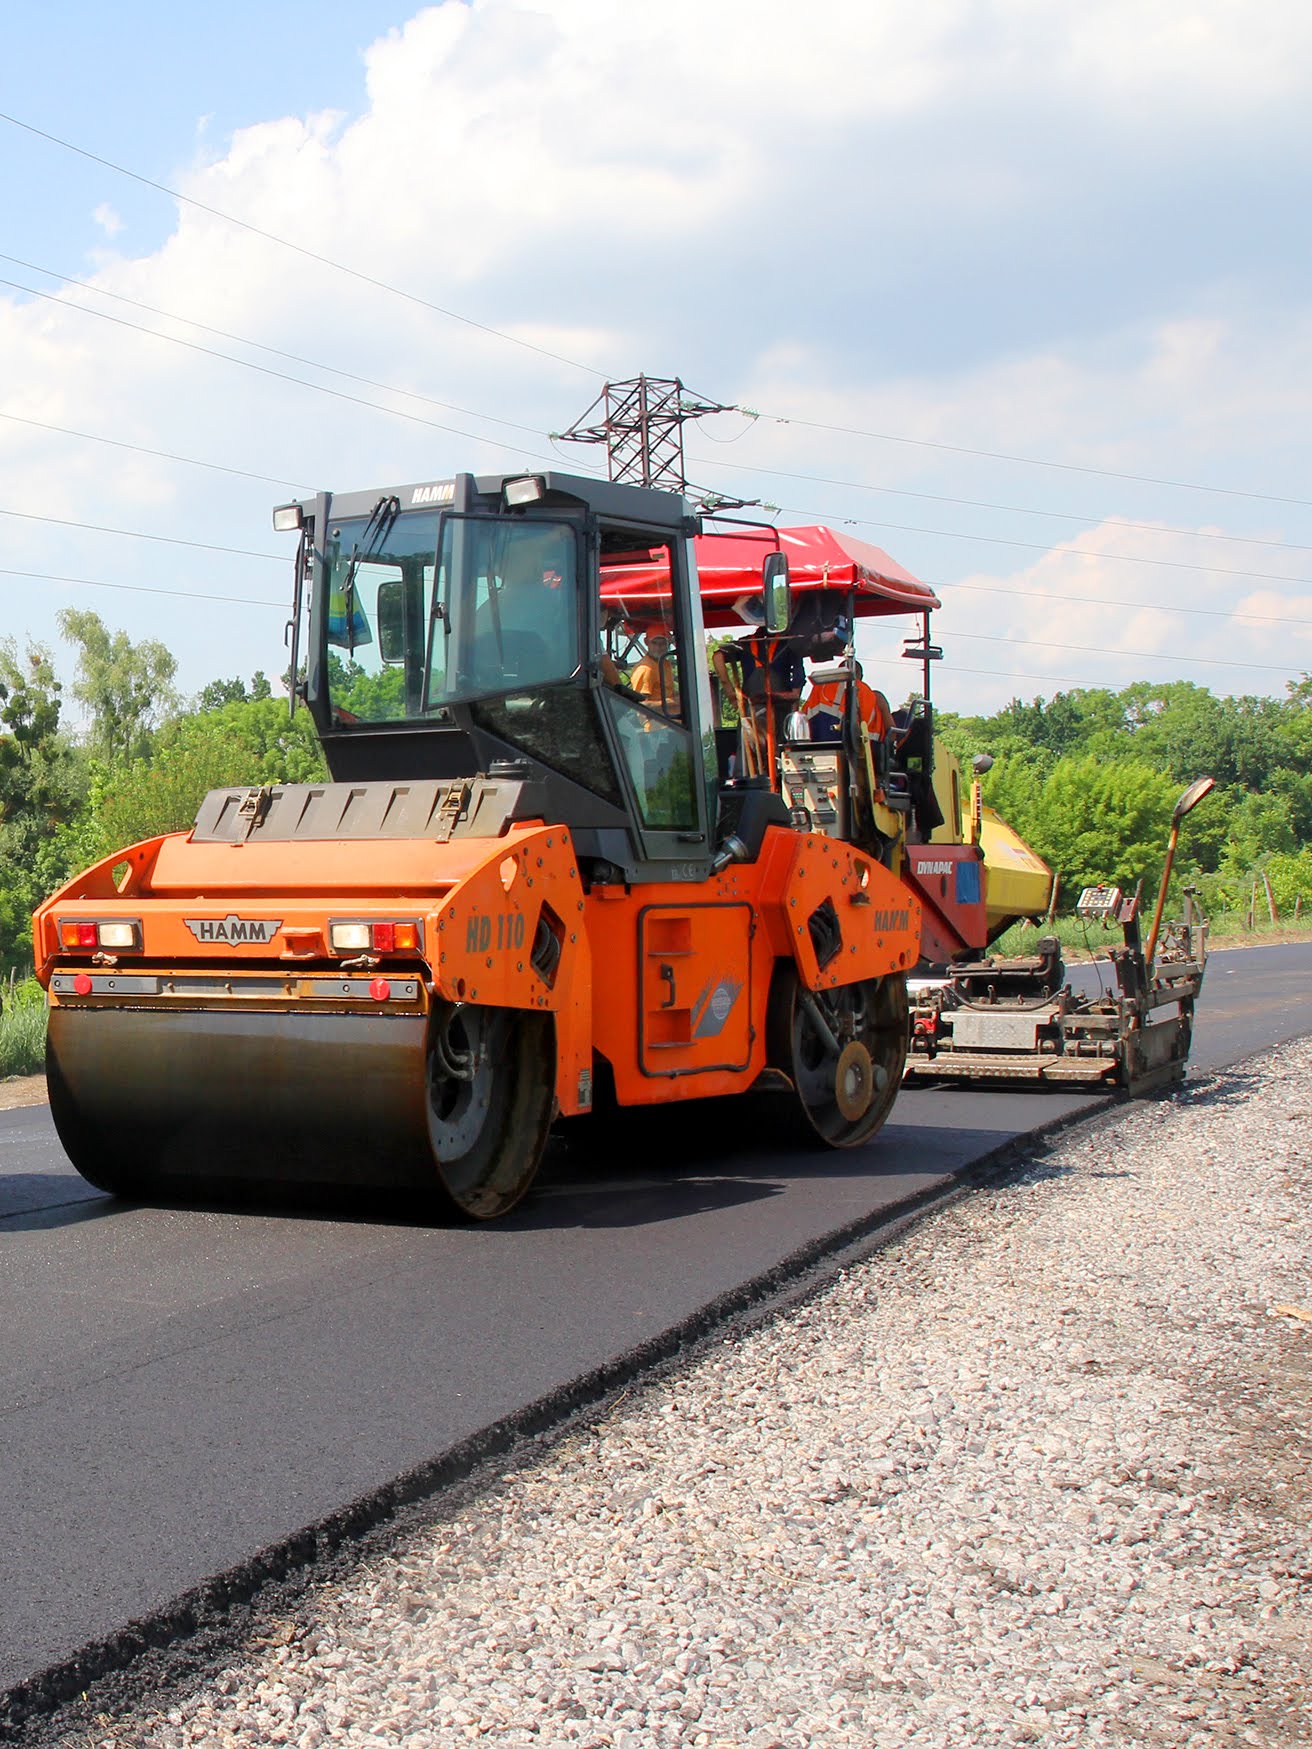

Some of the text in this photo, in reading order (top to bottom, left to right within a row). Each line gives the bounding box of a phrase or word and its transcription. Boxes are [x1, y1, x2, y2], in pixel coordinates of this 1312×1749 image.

[411, 484, 455, 504] HAMM
[917, 861, 953, 875] DYNAPAC
[199, 922, 266, 940] HAMM
[466, 913, 525, 953] HD 110
